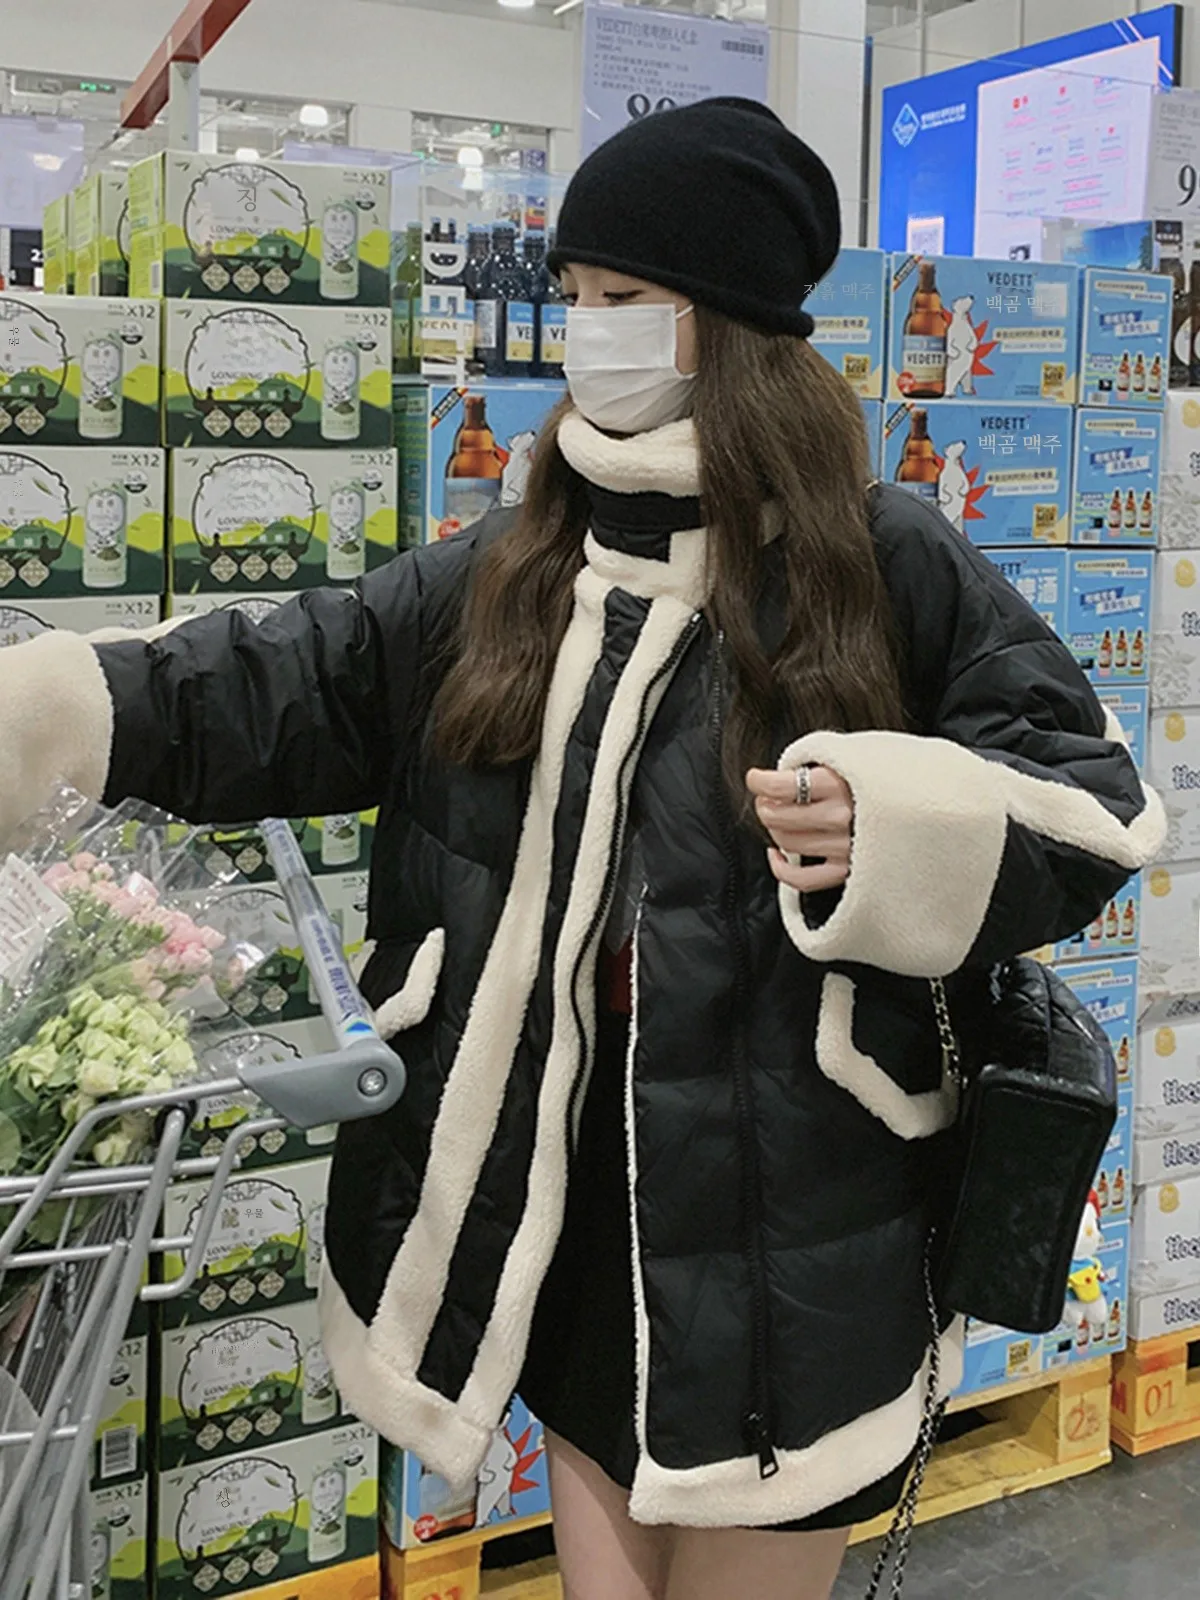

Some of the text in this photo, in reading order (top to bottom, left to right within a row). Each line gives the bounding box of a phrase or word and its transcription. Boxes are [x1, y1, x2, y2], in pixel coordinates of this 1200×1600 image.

[361, 172, 386, 186] X12
[987, 271, 1033, 287] VEDETT
[128, 305, 156, 319] X12
[362, 312, 388, 327] X12
[980, 416, 1026, 430] VEDETT
[131, 453, 160, 467] X12
[368, 453, 394, 467] X12
[126, 602, 153, 615] X12
[115, 1483, 143, 1499] X12
